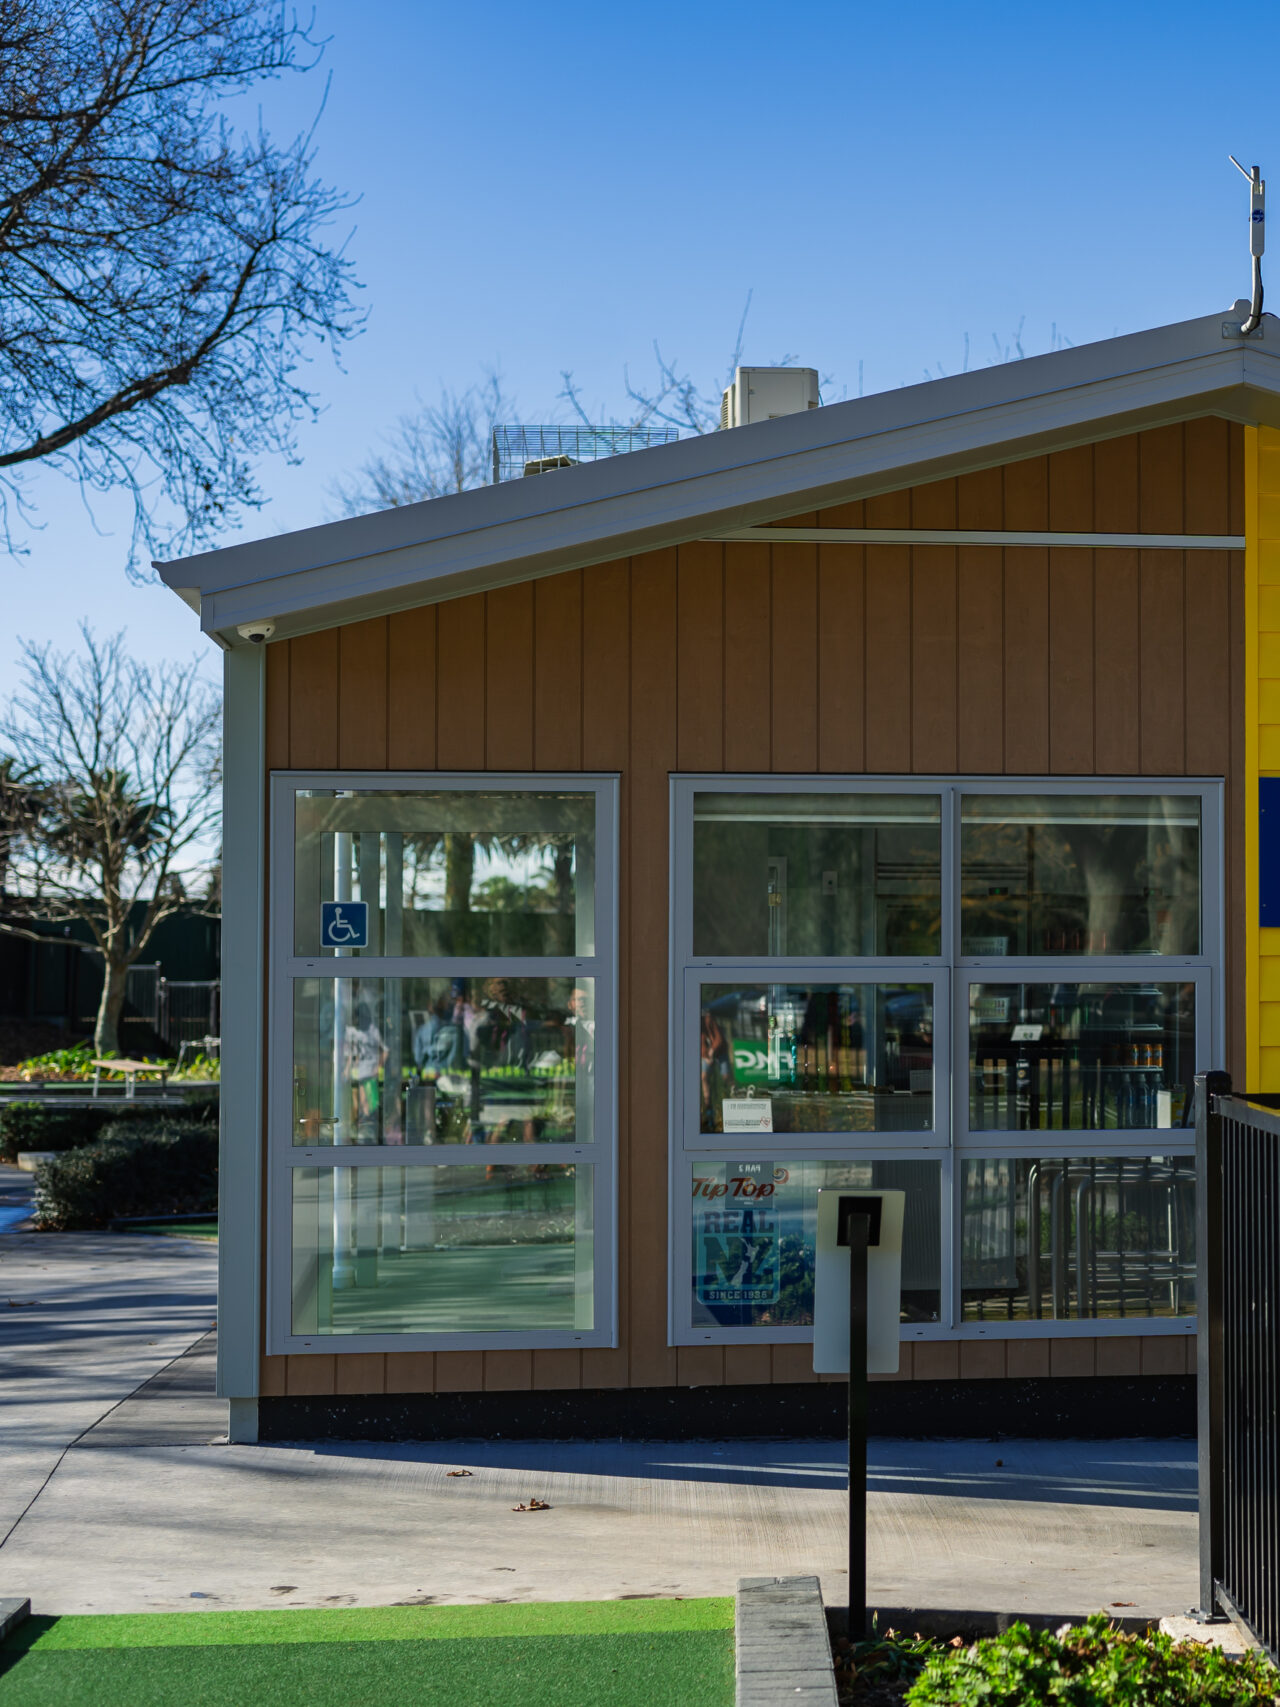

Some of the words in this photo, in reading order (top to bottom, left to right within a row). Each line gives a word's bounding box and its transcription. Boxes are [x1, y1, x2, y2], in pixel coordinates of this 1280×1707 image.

[692, 1177, 729, 1201] Tip
[729, 1176, 776, 1200] Top
[703, 1211, 774, 1233] REAL
[703, 1237, 774, 1285] NZ
[708, 1291, 740, 1299] SINCE
